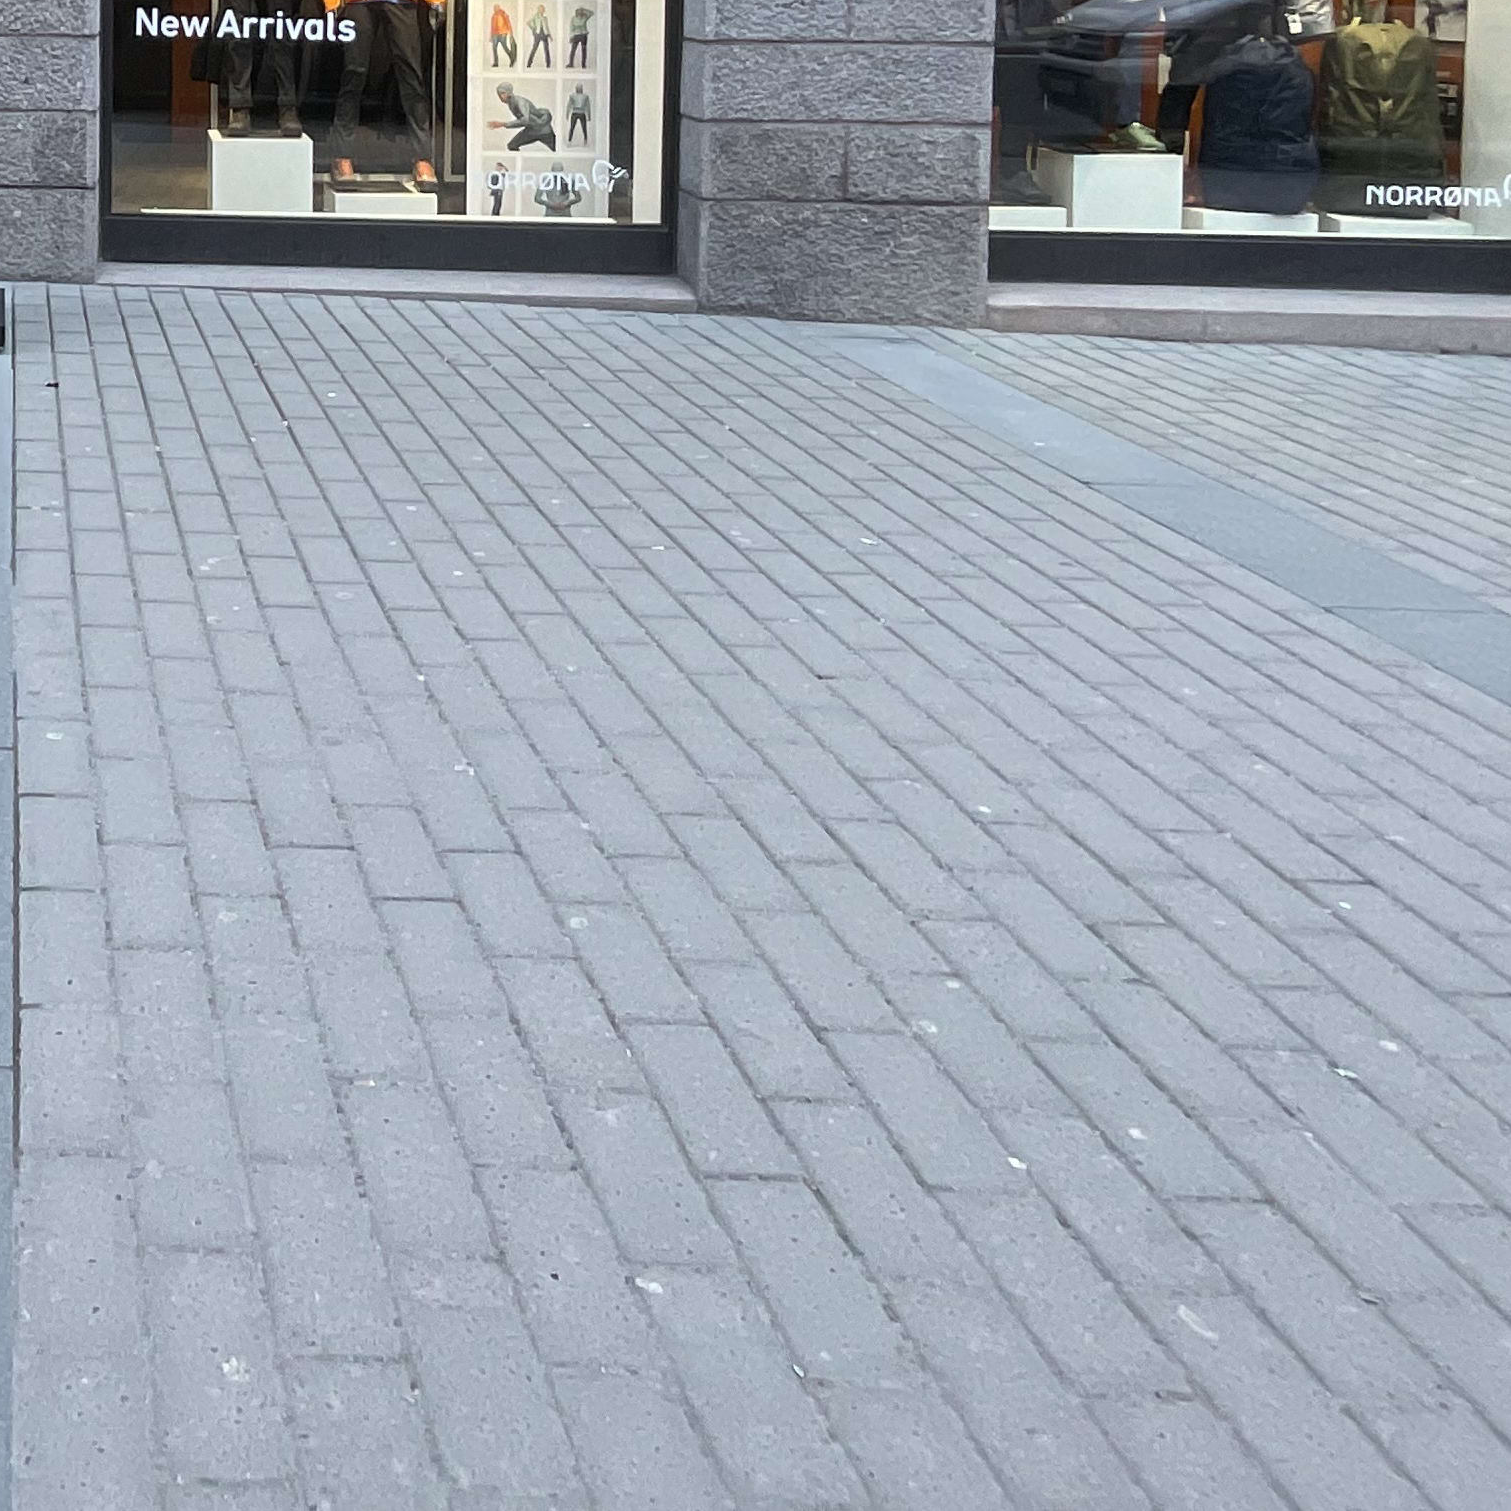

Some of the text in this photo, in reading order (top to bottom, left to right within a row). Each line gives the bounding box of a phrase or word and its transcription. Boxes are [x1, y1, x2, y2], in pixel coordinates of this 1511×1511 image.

[135, 7, 357, 43] New Arrivals
[475, 171, 591, 193] ORRØNA
[1366, 184, 1502, 208] NORRØNA
